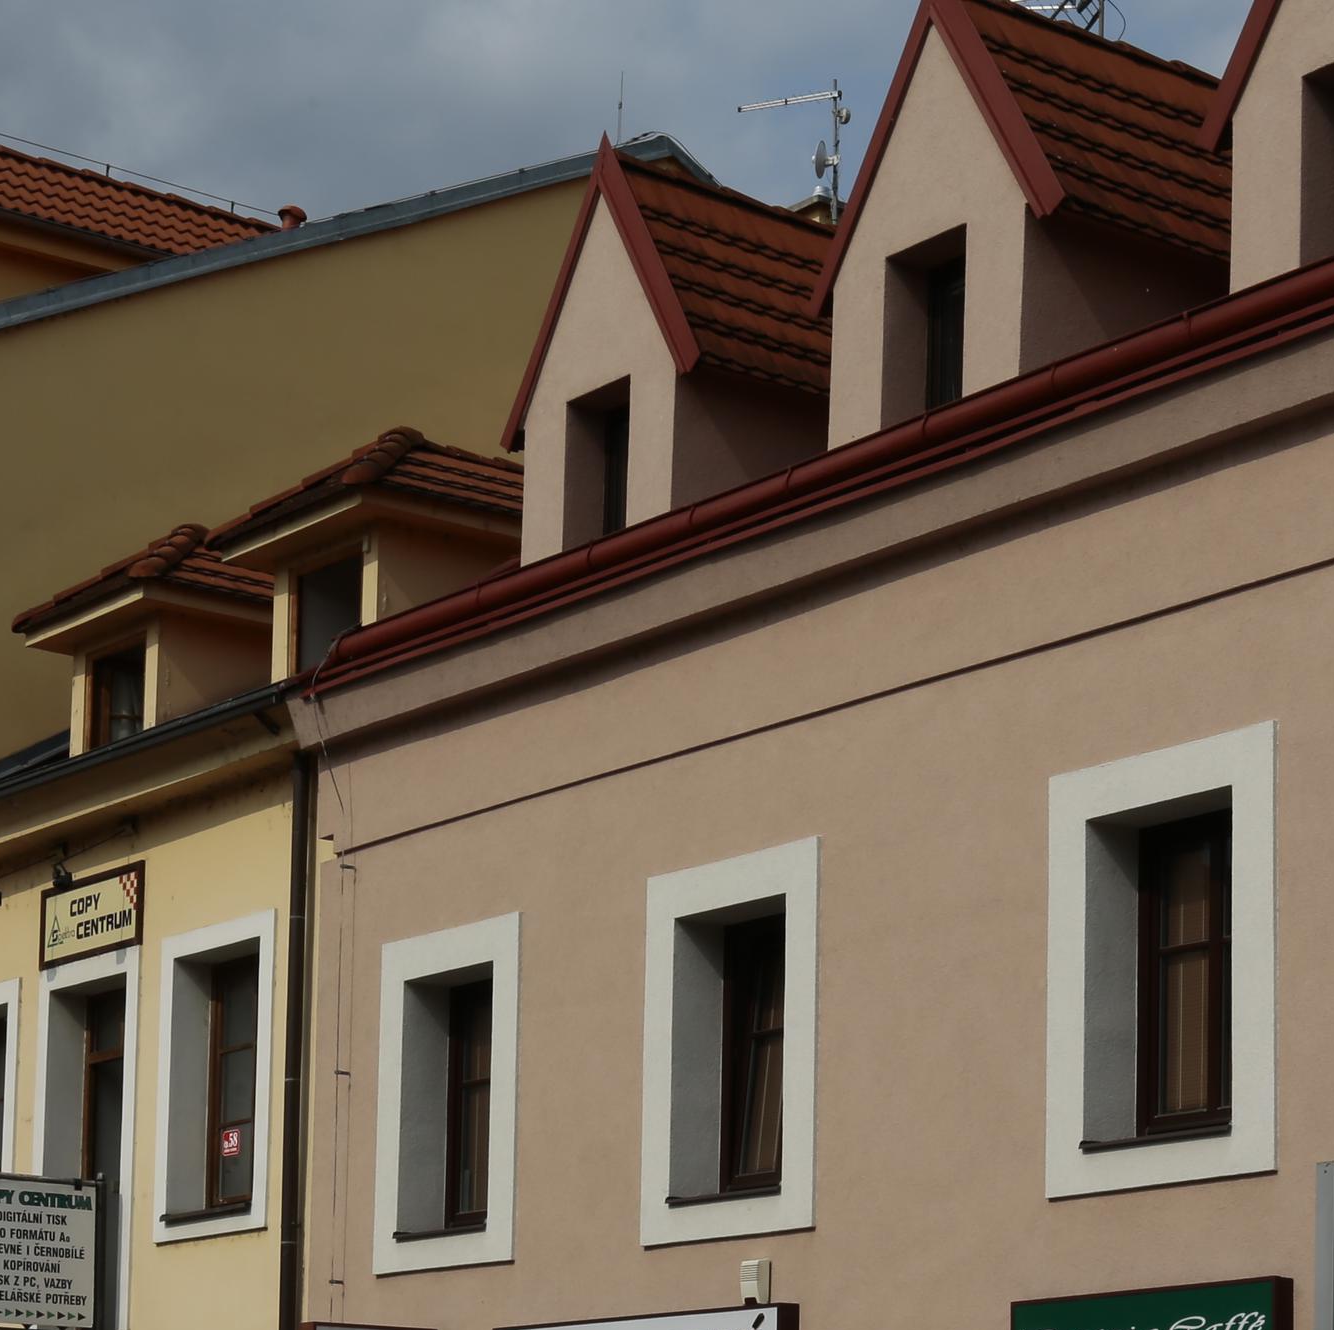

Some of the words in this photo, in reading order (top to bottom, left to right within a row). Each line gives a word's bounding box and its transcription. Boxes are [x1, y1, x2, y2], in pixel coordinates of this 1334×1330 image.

[70, 893, 100, 917] COPY
[77, 908, 132, 939] CENTRUM
[18, 1191, 93, 1210] CENTRUM
[46, 1214, 68, 1226] TISK
[10, 1228, 56, 1242] FORMÁTU
[26, 1245, 30, 1256] I
[34, 1243, 85, 1260] ČERNOBÍLÉ
[3, 1258, 61, 1273] KOPÍROVÁNÍ
[14, 1275, 20, 1286] Z
[23, 1276, 40, 1289] PC,
[44, 1278, 73, 1290] VAZBY
[46, 1291, 87, 1306] POTŘEBY
